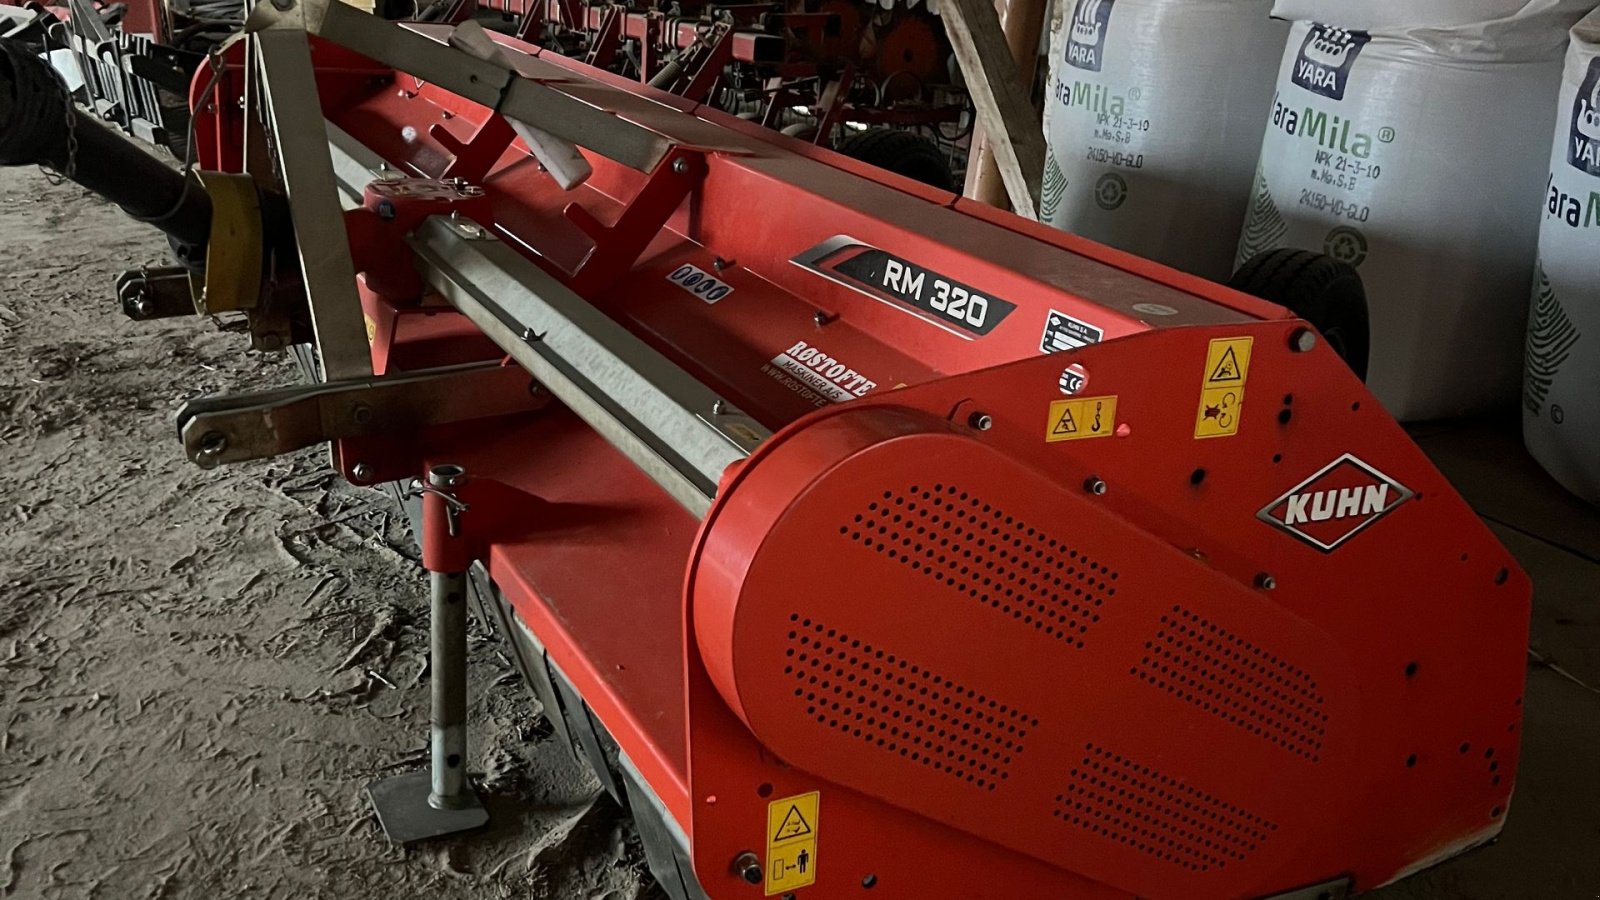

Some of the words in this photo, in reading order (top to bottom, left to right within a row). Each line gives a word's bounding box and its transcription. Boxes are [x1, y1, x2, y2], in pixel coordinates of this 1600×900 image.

[1068, 43, 1096, 65] YARA
[1298, 60, 1336, 91] YARA
[1113, 115, 1150, 131] 21-3-10
[1314, 149, 1333, 168] NPK
[1335, 155, 1381, 179] 21-3-10
[883, 259, 925, 301] RM
[930, 279, 988, 328] 320
[782, 361, 826, 391] MASKINER
[822, 387, 843, 399] A/S
[786, 341, 877, 397] RØSTOFTE
[1285, 483, 1389, 525] KUHN
